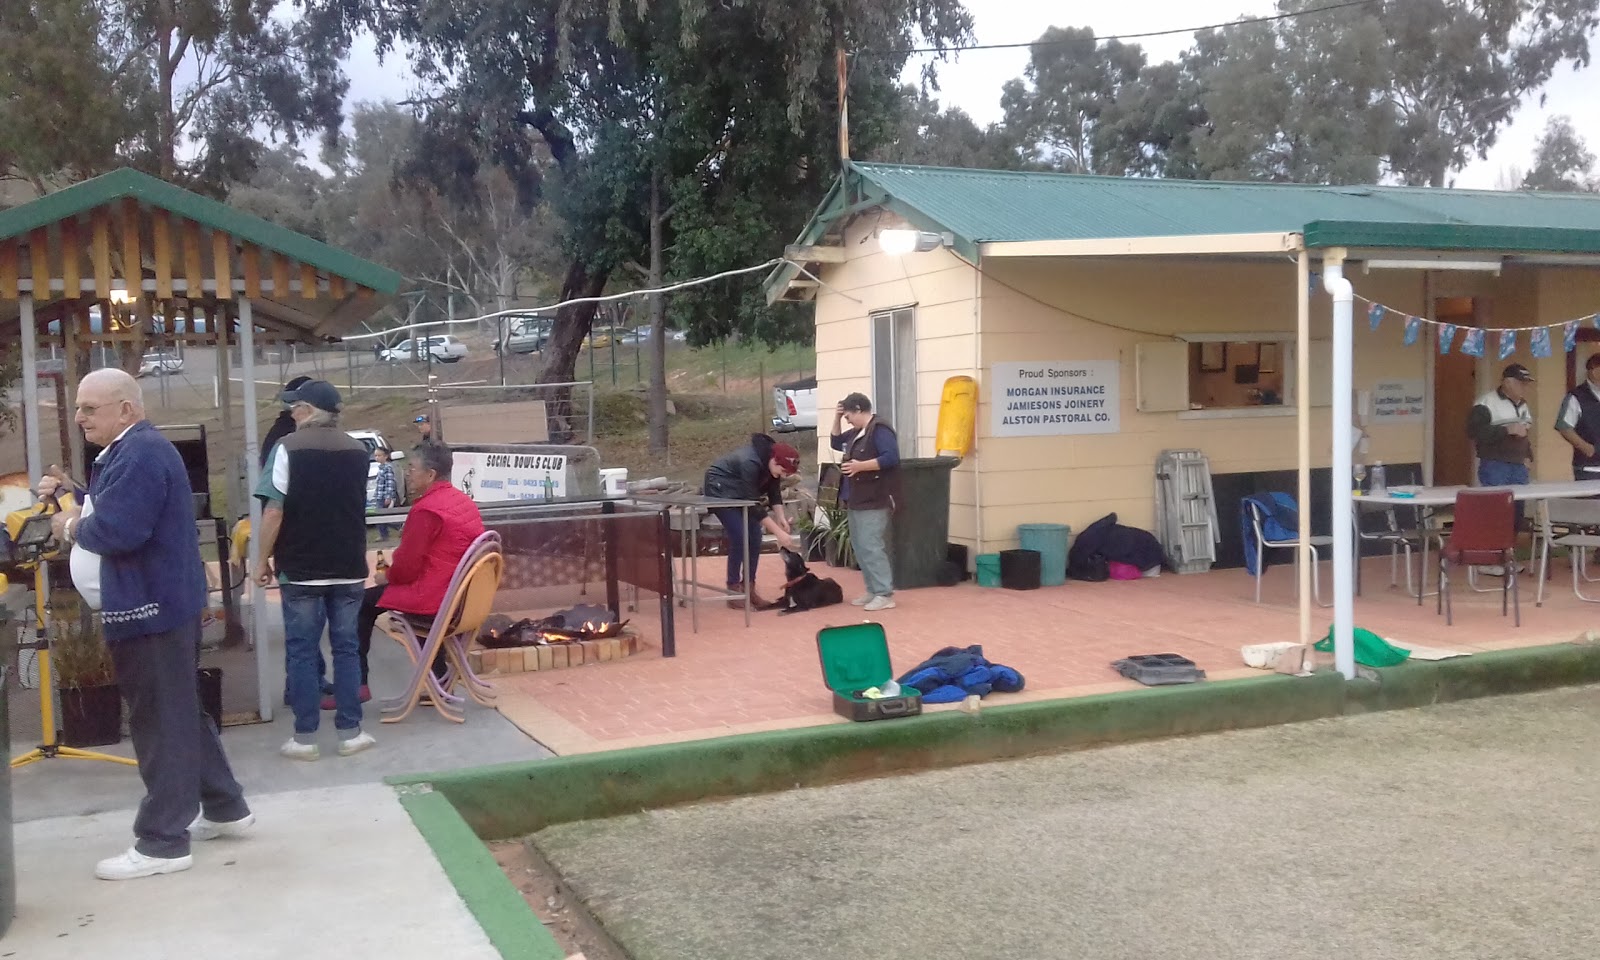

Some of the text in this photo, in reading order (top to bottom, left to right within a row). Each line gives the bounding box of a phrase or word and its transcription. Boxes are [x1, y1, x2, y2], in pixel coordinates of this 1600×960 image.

[1019, 369, 1044, 378] Proud
[1047, 368, 1087, 379] Sponsors
[1006, 385, 1105, 397] MORGAN INSURANCE
[1007, 399, 1105, 411] JAMIESONS JOINERY
[1002, 413, 1110, 425] ALSTON PASTORAL CO.
[486, 454, 511, 468] SOCIAL
[513, 455, 541, 469] BOWLS
[541, 456, 563, 471] CLUB
